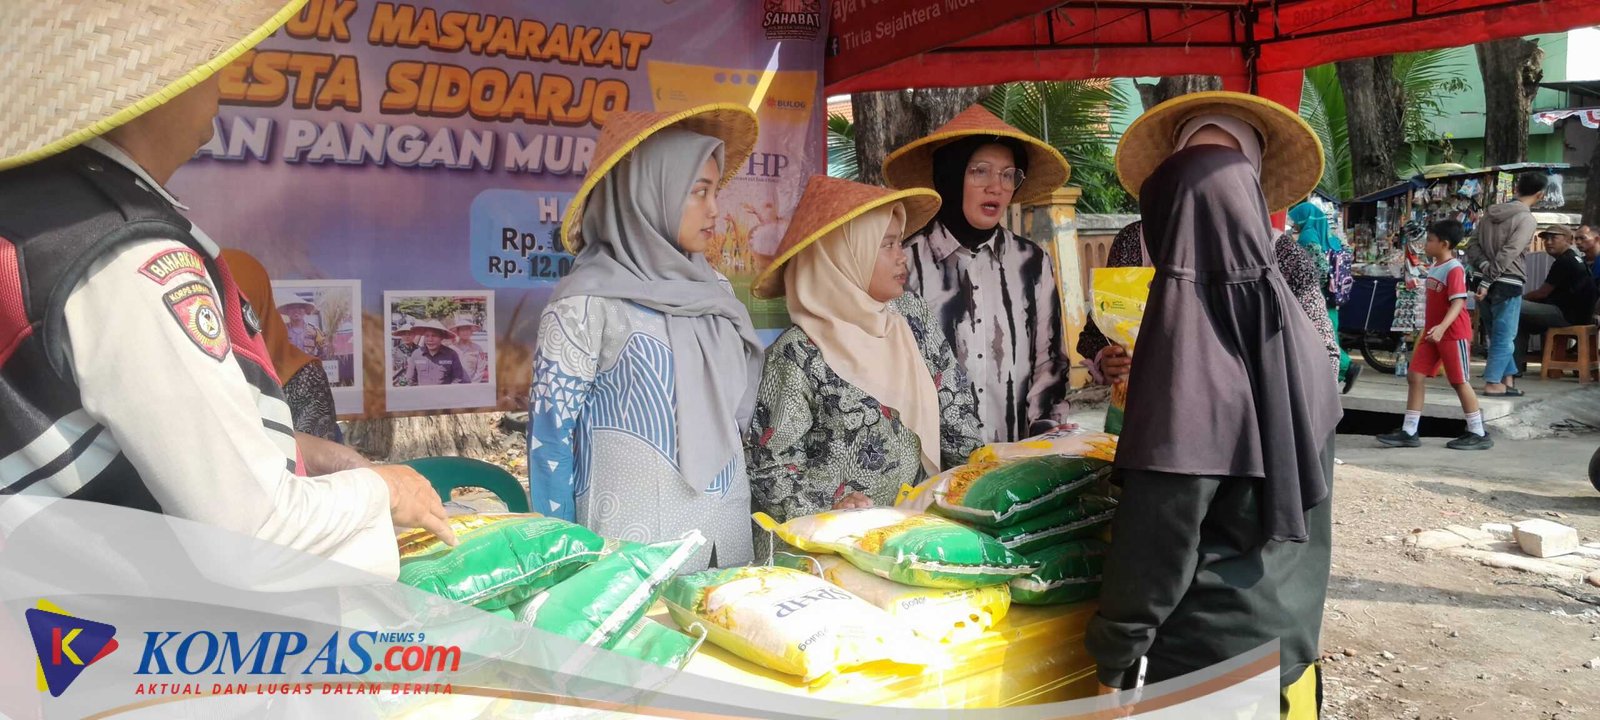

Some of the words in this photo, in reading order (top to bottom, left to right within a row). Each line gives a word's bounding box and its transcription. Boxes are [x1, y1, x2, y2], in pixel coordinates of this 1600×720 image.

[368, 2, 653, 70] MASYARAKAT
[763, 12, 820, 27] SAHABAT
[875, 3, 941, 39] Sejahtera
[380, 60, 630, 129] SIDOARJO
[283, 118, 498, 171] PANGAN
[746, 152, 788, 177] HP
[502, 227, 544, 258] Rp.
[488, 255, 523, 279] Rp.
